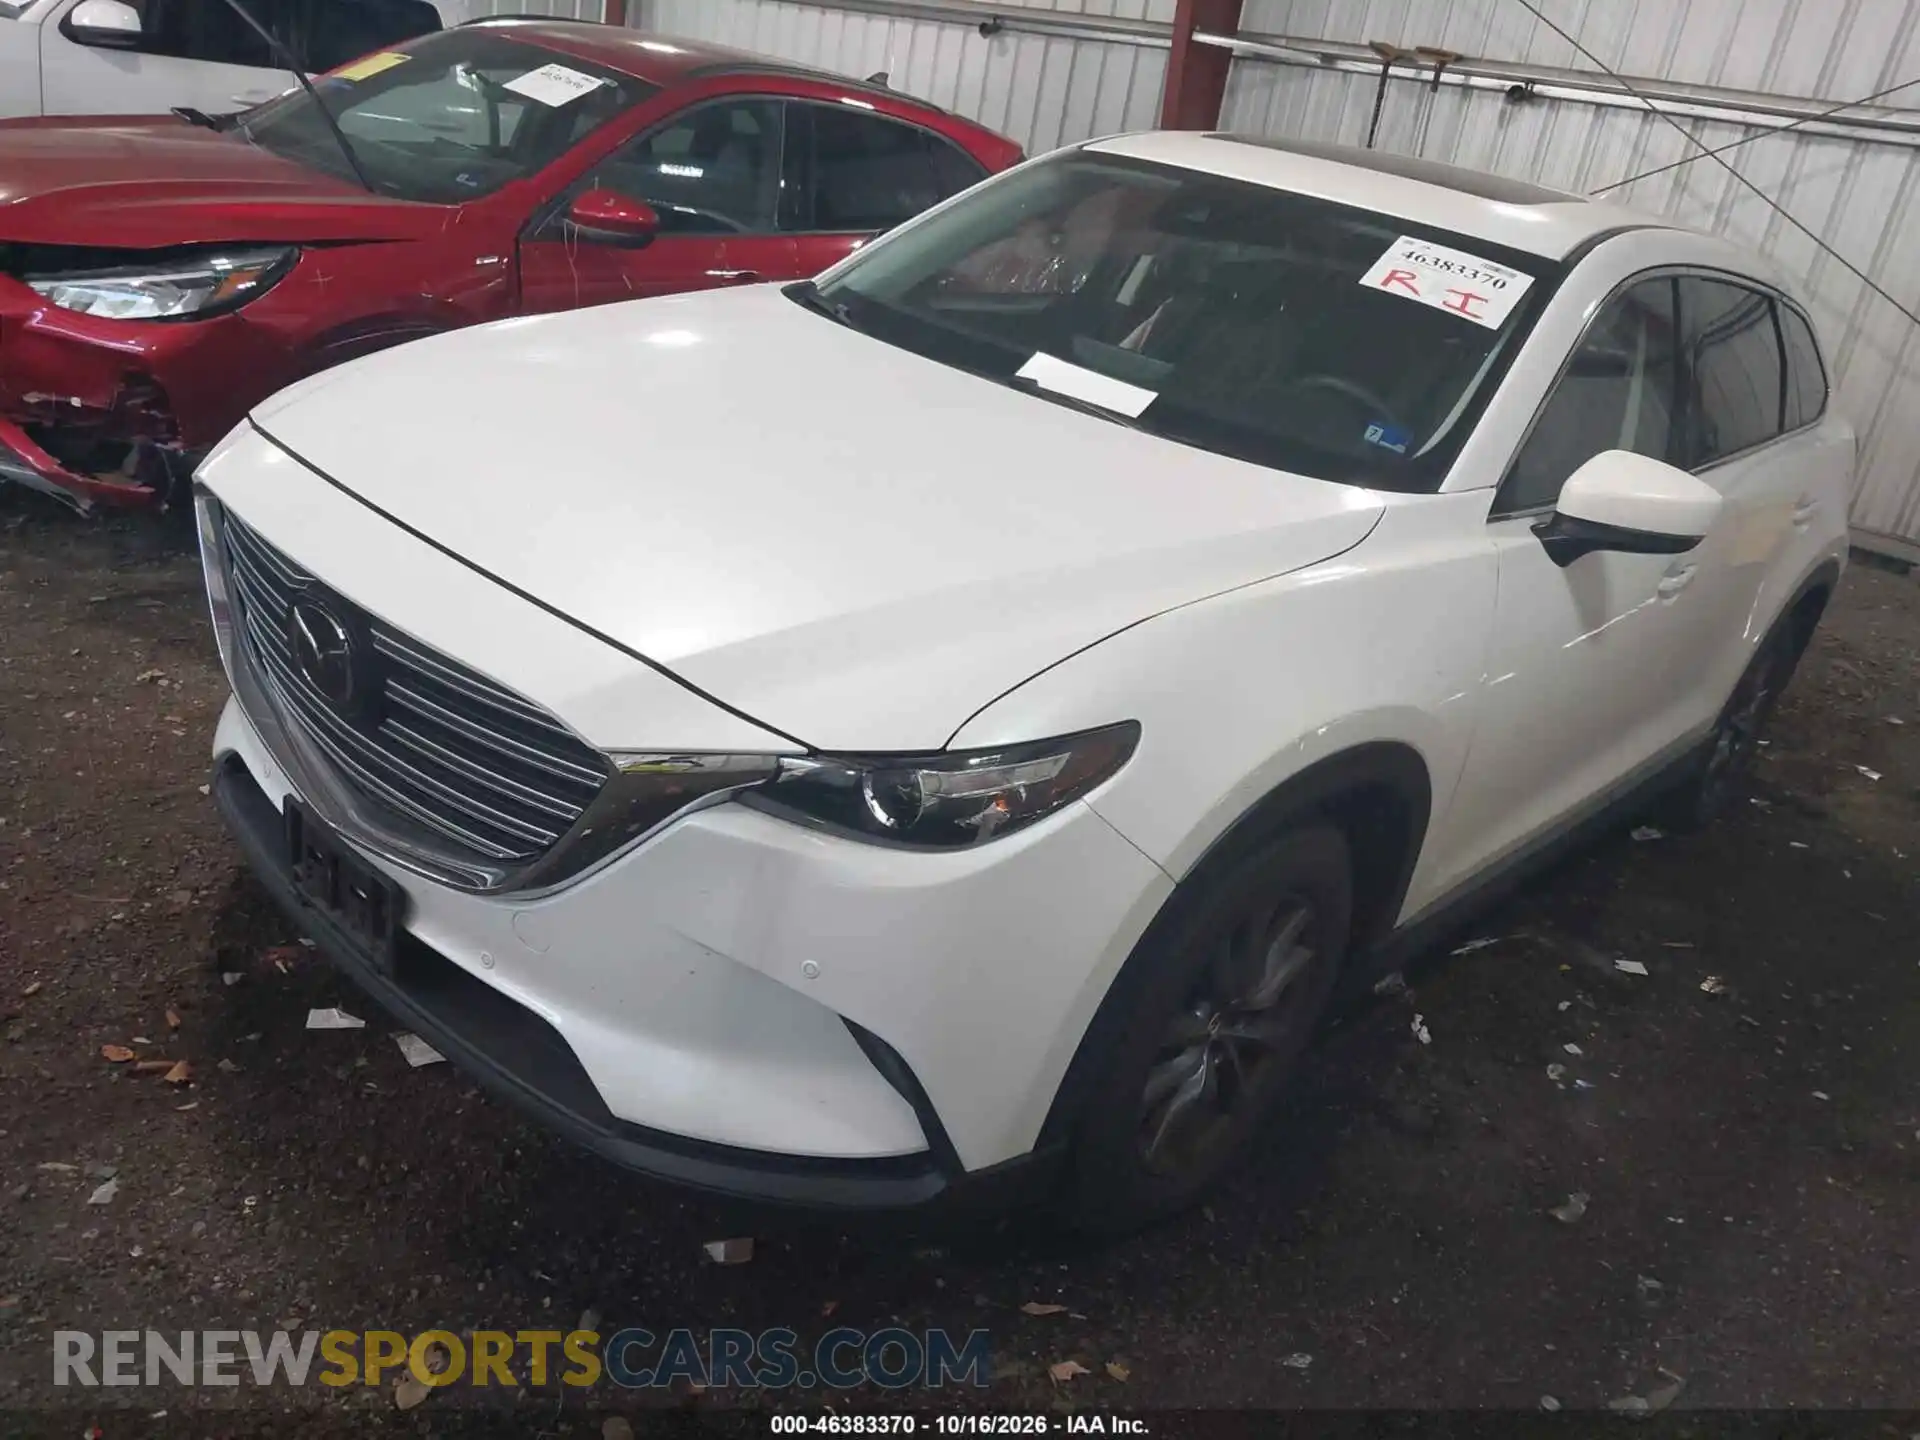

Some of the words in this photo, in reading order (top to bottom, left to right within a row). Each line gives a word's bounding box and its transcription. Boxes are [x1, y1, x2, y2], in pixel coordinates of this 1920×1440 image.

[1401, 250, 1507, 290] 46383370
[1380, 269, 1420, 297] R
[1442, 288, 1489, 319] I
